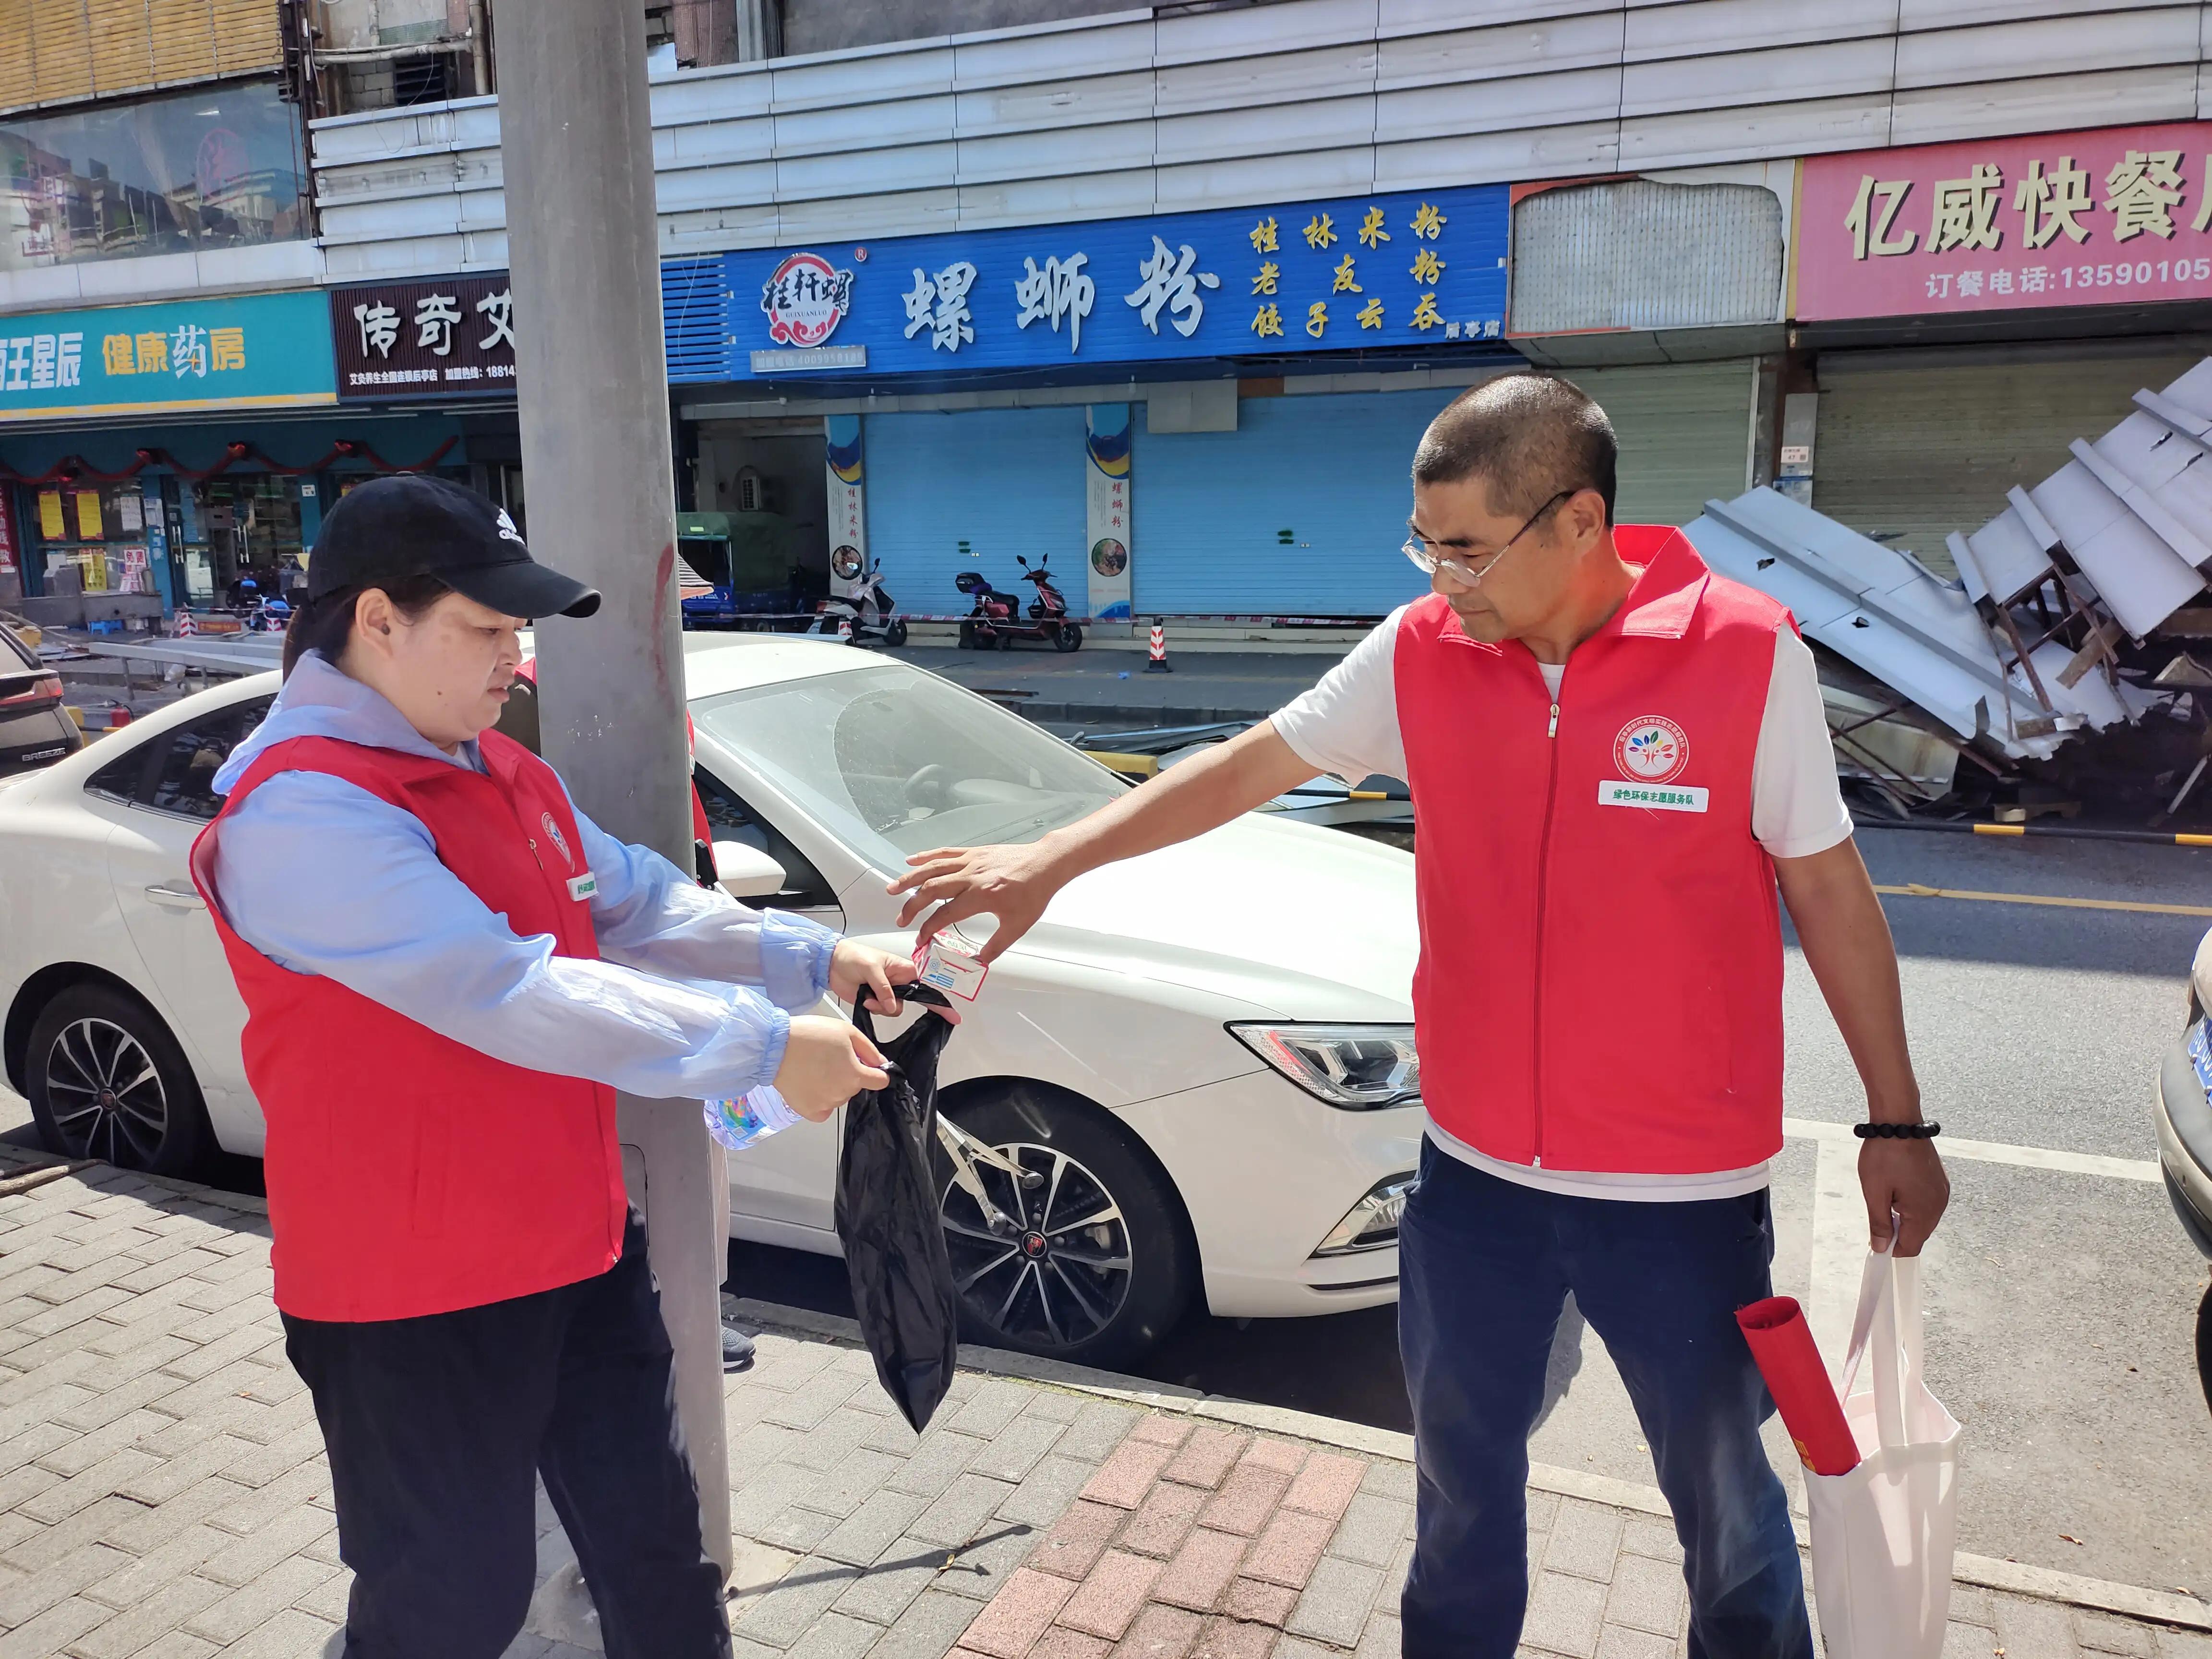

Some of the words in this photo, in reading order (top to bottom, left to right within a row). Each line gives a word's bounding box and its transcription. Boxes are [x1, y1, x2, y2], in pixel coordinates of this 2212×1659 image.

[1250, 202, 1447, 254] 桂林米粉
[764, 269, 851, 312] 桂轩螺
[901, 235, 1221, 355] 螺蛳粉
[1250, 247, 1446, 296] 老友粉
[1925, 258, 2210, 299] 订餐电话:13590105
[353, 288, 516, 359] 传奇艾
[786, 309, 827, 318] GUIXUANLUO
[1251, 292, 1446, 339] 饺子云吞
[102, 324, 246, 379] 健康药房
[22, 747, 66, 762] BREEZE
[1613, 789, 1694, 805] 绿色环保志愿服务队
